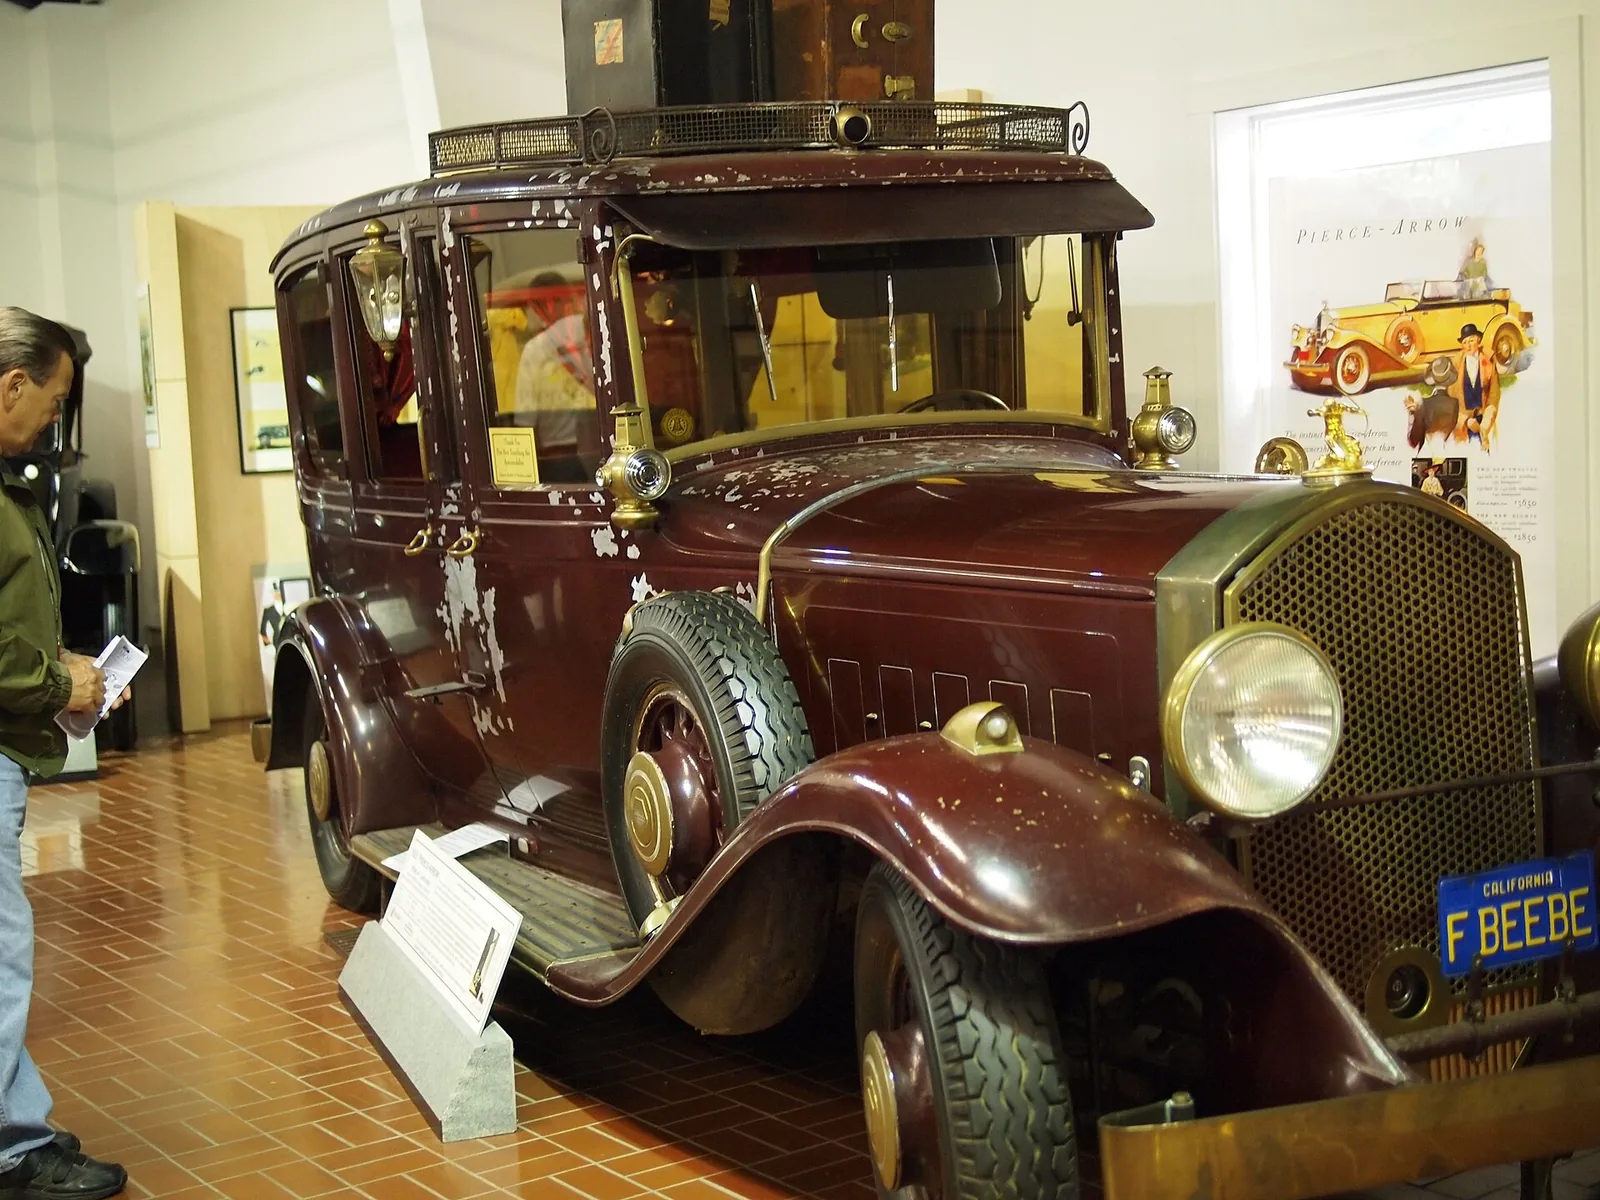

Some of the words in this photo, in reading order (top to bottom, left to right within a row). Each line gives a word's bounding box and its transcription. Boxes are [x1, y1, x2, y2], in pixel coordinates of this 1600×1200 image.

[1297, 216, 1468, 244] PIERCE-ARROW
[1299, 430, 1324, 439] instinct
[1379, 443, 1395, 452] than
[1483, 870, 1554, 897] CALIFORNIA
[1446, 911, 1468, 963] F
[1478, 886, 1592, 957] BEEBE
